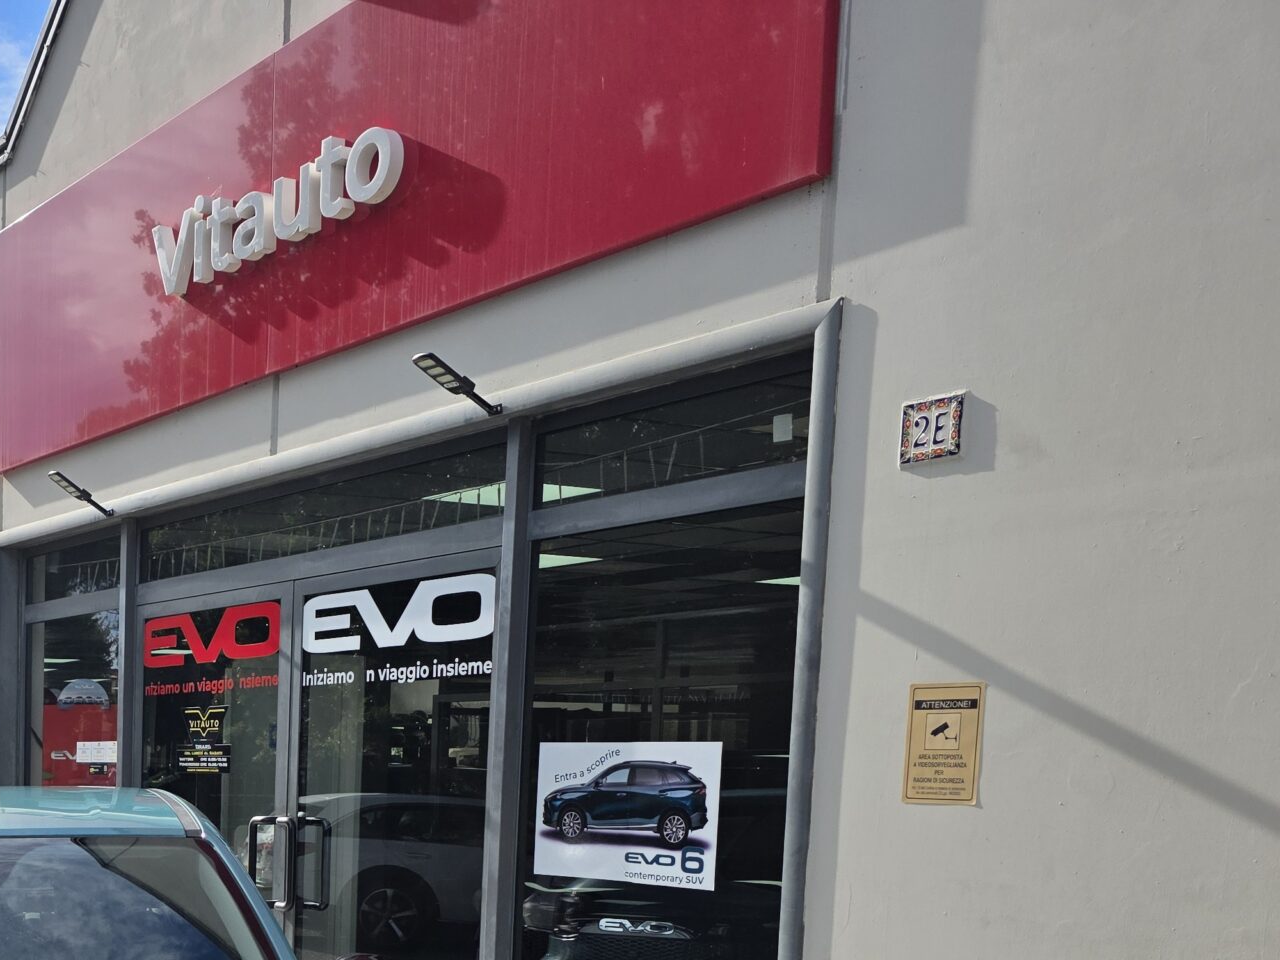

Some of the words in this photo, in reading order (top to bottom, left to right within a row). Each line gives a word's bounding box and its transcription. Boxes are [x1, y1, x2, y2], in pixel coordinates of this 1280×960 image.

[152, 126, 404, 296] Vitauto
[913, 411, 949, 448] 2E
[302, 573, 496, 654] EVO
[144, 601, 281, 668] EVO
[182, 681, 195, 693] un
[197, 677, 234, 694] viaggio
[302, 667, 355, 687] Iniziamo
[378, 660, 429, 684] viaggio
[432, 658, 493, 678] insieme
[920, 700, 972, 709] ATTENZIONE!
[188, 719, 220, 728] VITAUTO
[50, 750, 78, 760] EV
[554, 771, 578, 784] Entra
[579, 769, 585, 778] a
[586, 748, 621, 774] scoprire
[624, 851, 676, 867] EVO
[681, 846, 705, 875] 6
[624, 871, 683, 885] contemporary
[685, 875, 705, 885] SUV
[599, 918, 674, 935] EVO
